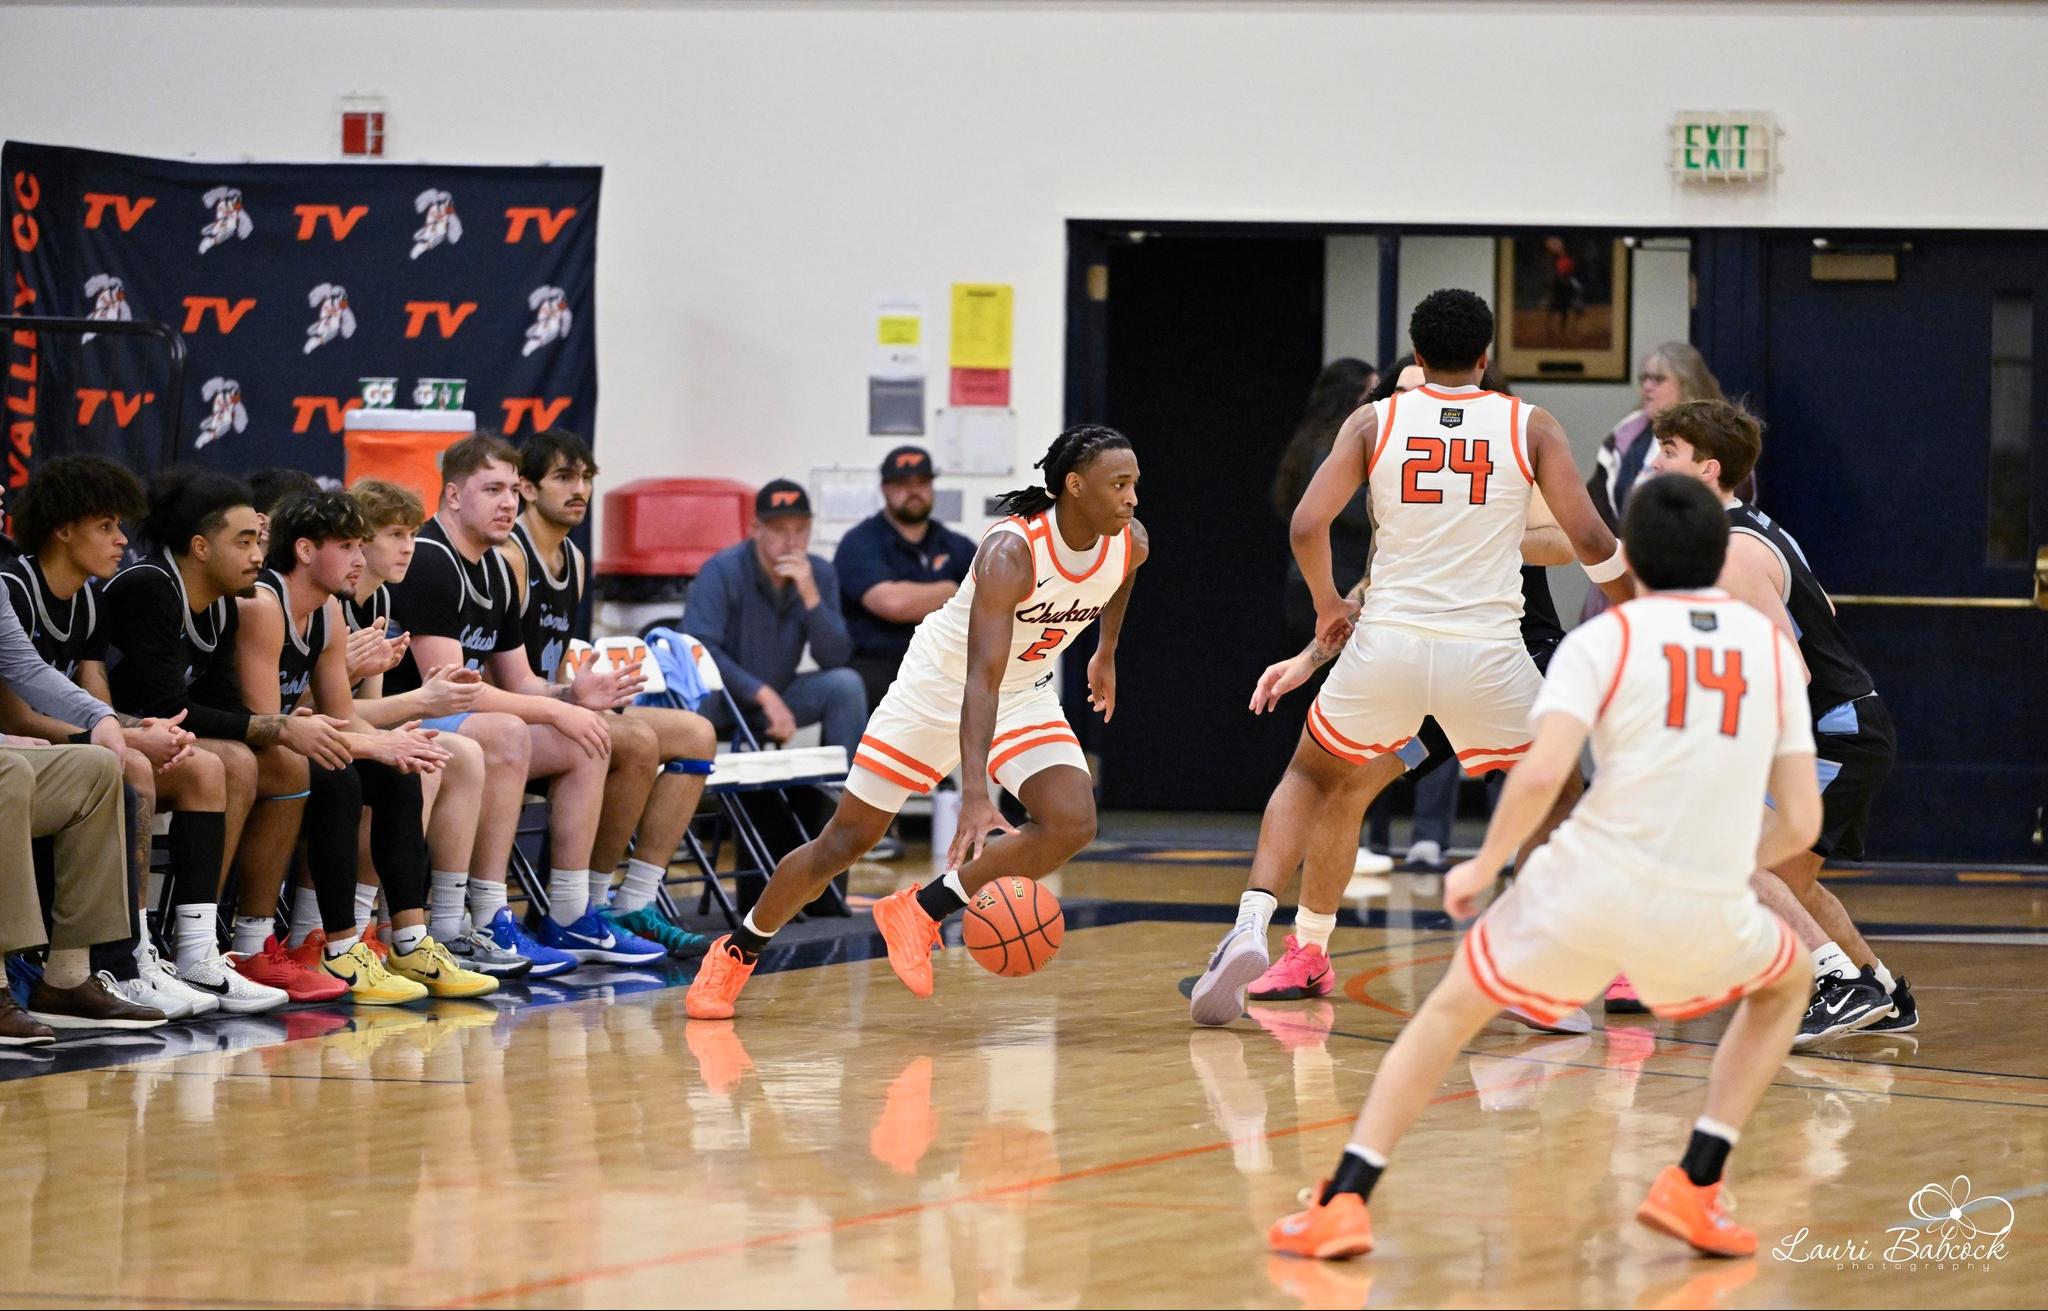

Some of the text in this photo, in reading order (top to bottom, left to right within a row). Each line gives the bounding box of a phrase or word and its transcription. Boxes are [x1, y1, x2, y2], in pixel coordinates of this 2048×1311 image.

[1685, 124, 1749, 169] EXIT
[12, 171, 40, 252] CC
[83, 193, 156, 232] TV
[294, 204, 368, 242] TV
[505, 206, 577, 244] TV
[181, 296, 257, 335] TV
[404, 301, 478, 338] TV
[75, 388, 155, 427] TV
[502, 397, 573, 435] TV
[1401, 436, 1492, 505] 24
[1017, 627, 1068, 662] 2
[1662, 643, 1746, 737] 14
